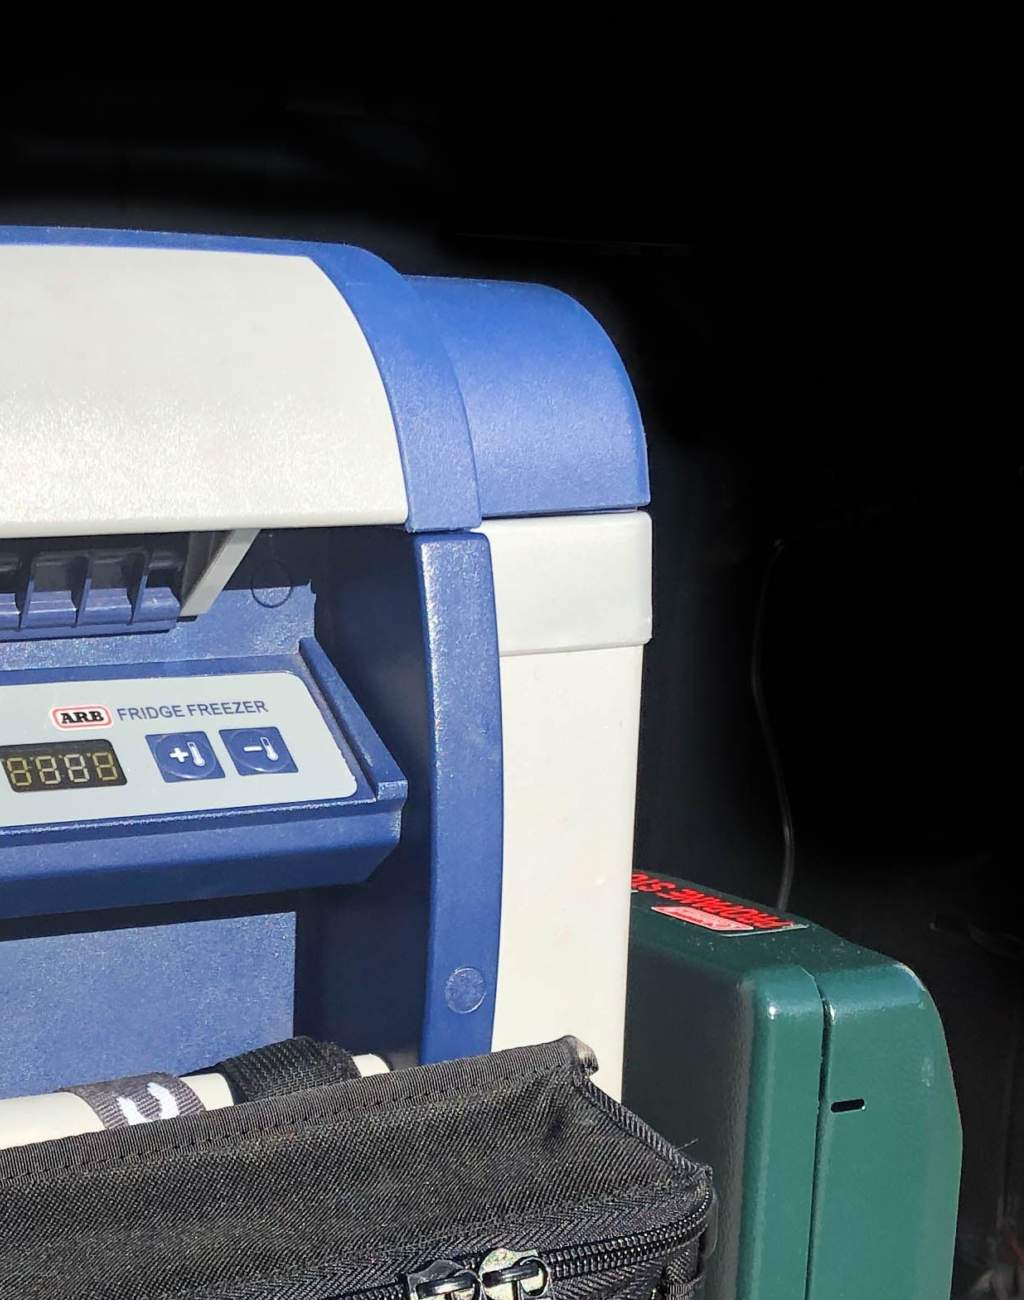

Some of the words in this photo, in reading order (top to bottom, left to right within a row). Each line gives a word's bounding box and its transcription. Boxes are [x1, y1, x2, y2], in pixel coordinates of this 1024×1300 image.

[60, 710, 105, 724] ARB
[117, 705, 184, 721] FRIDGE
[186, 700, 269, 717] FREEZER
